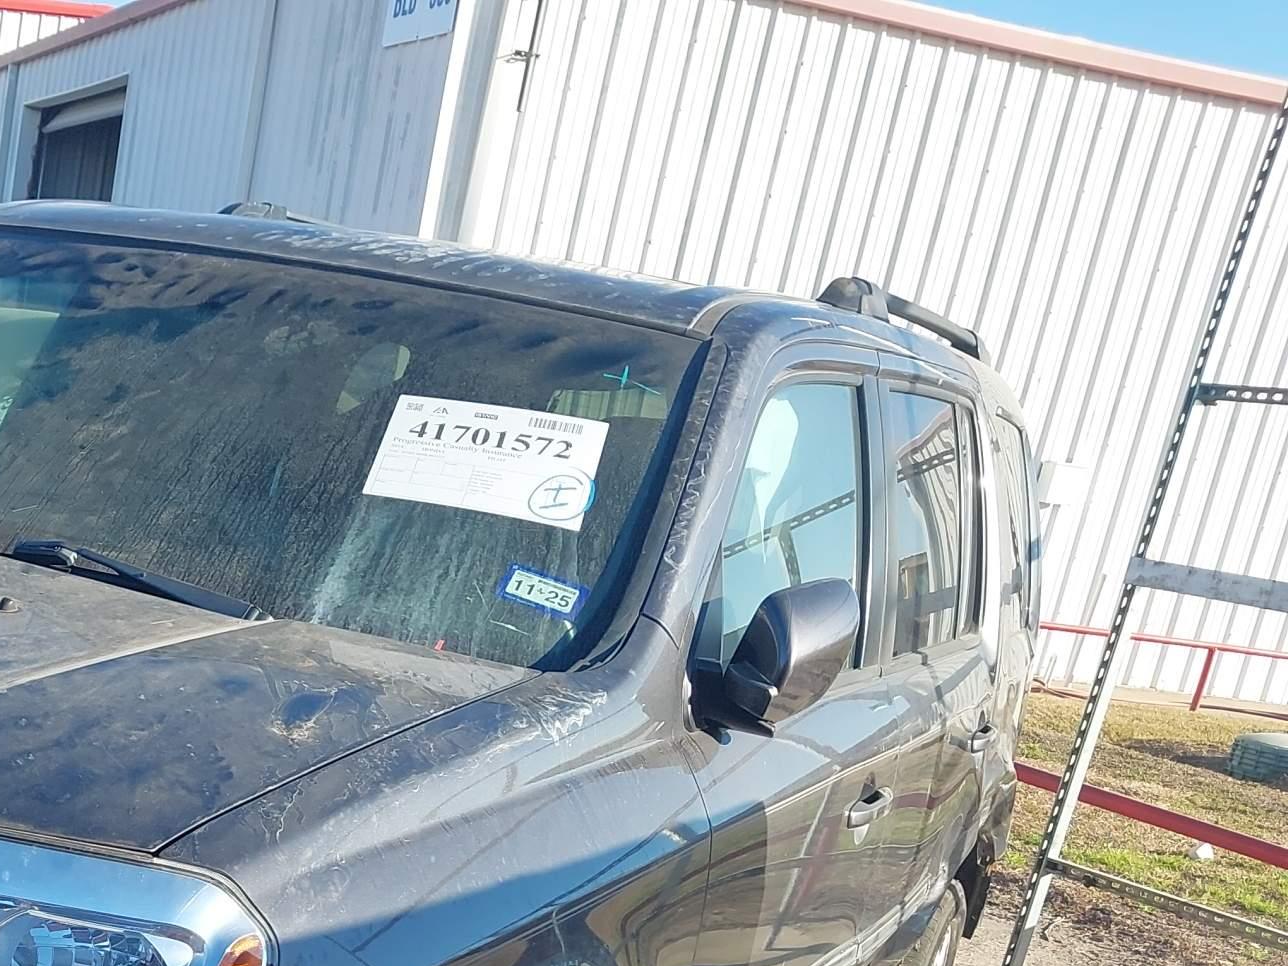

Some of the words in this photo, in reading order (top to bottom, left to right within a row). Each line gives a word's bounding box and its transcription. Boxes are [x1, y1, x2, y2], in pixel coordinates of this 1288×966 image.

[393, 437, 441, 449] Progressive
[443, 442, 478, 454] Casualty
[481, 447, 523, 459] Insurance
[409, 420, 573, 459] 41701572
[544, 590, 572, 608] 25
